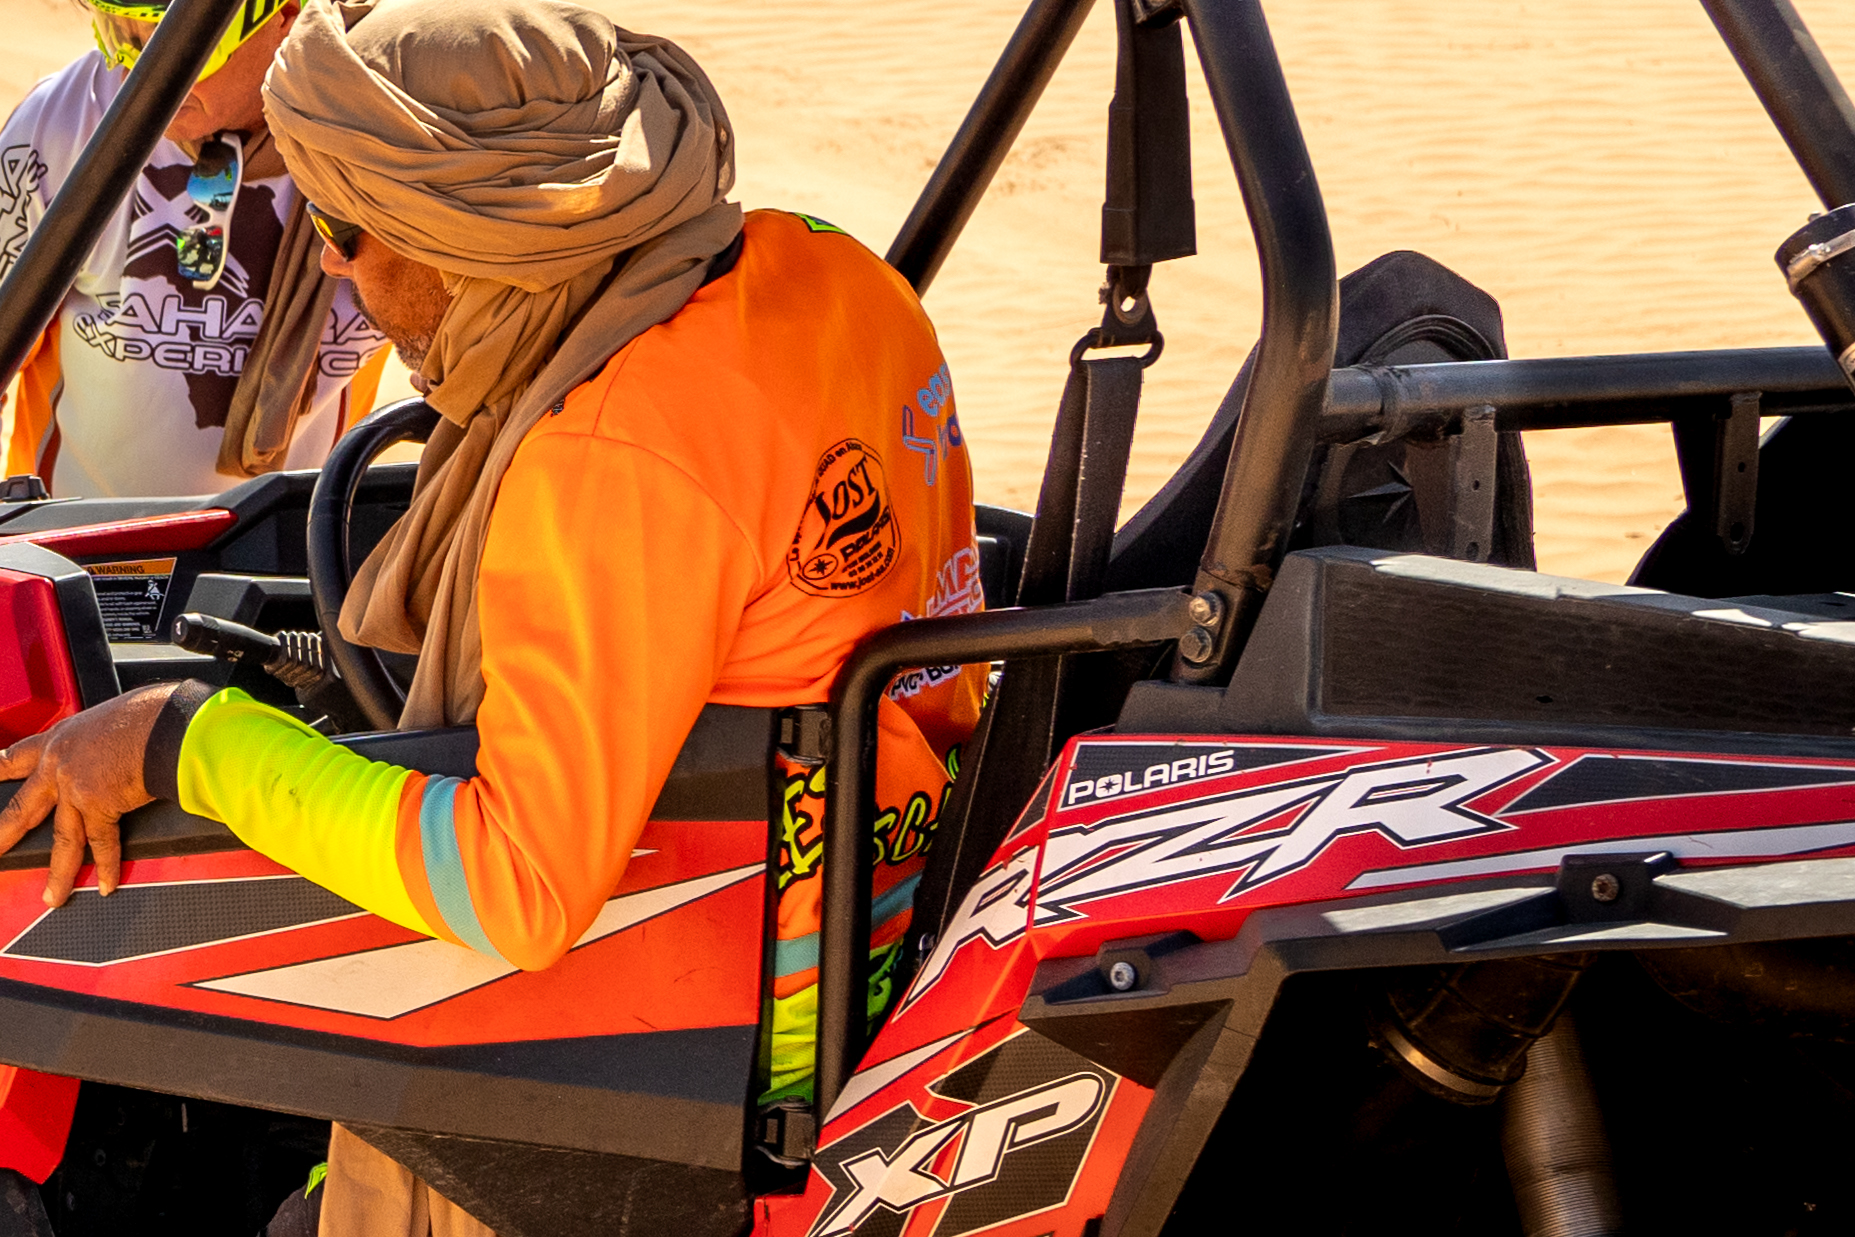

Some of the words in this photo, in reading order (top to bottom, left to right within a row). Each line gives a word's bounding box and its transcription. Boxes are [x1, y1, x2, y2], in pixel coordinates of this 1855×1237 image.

[96, 565, 145, 576] WARNING
[1067, 749, 1235, 805] POLARIS
[899, 746, 1551, 1015] RZR
